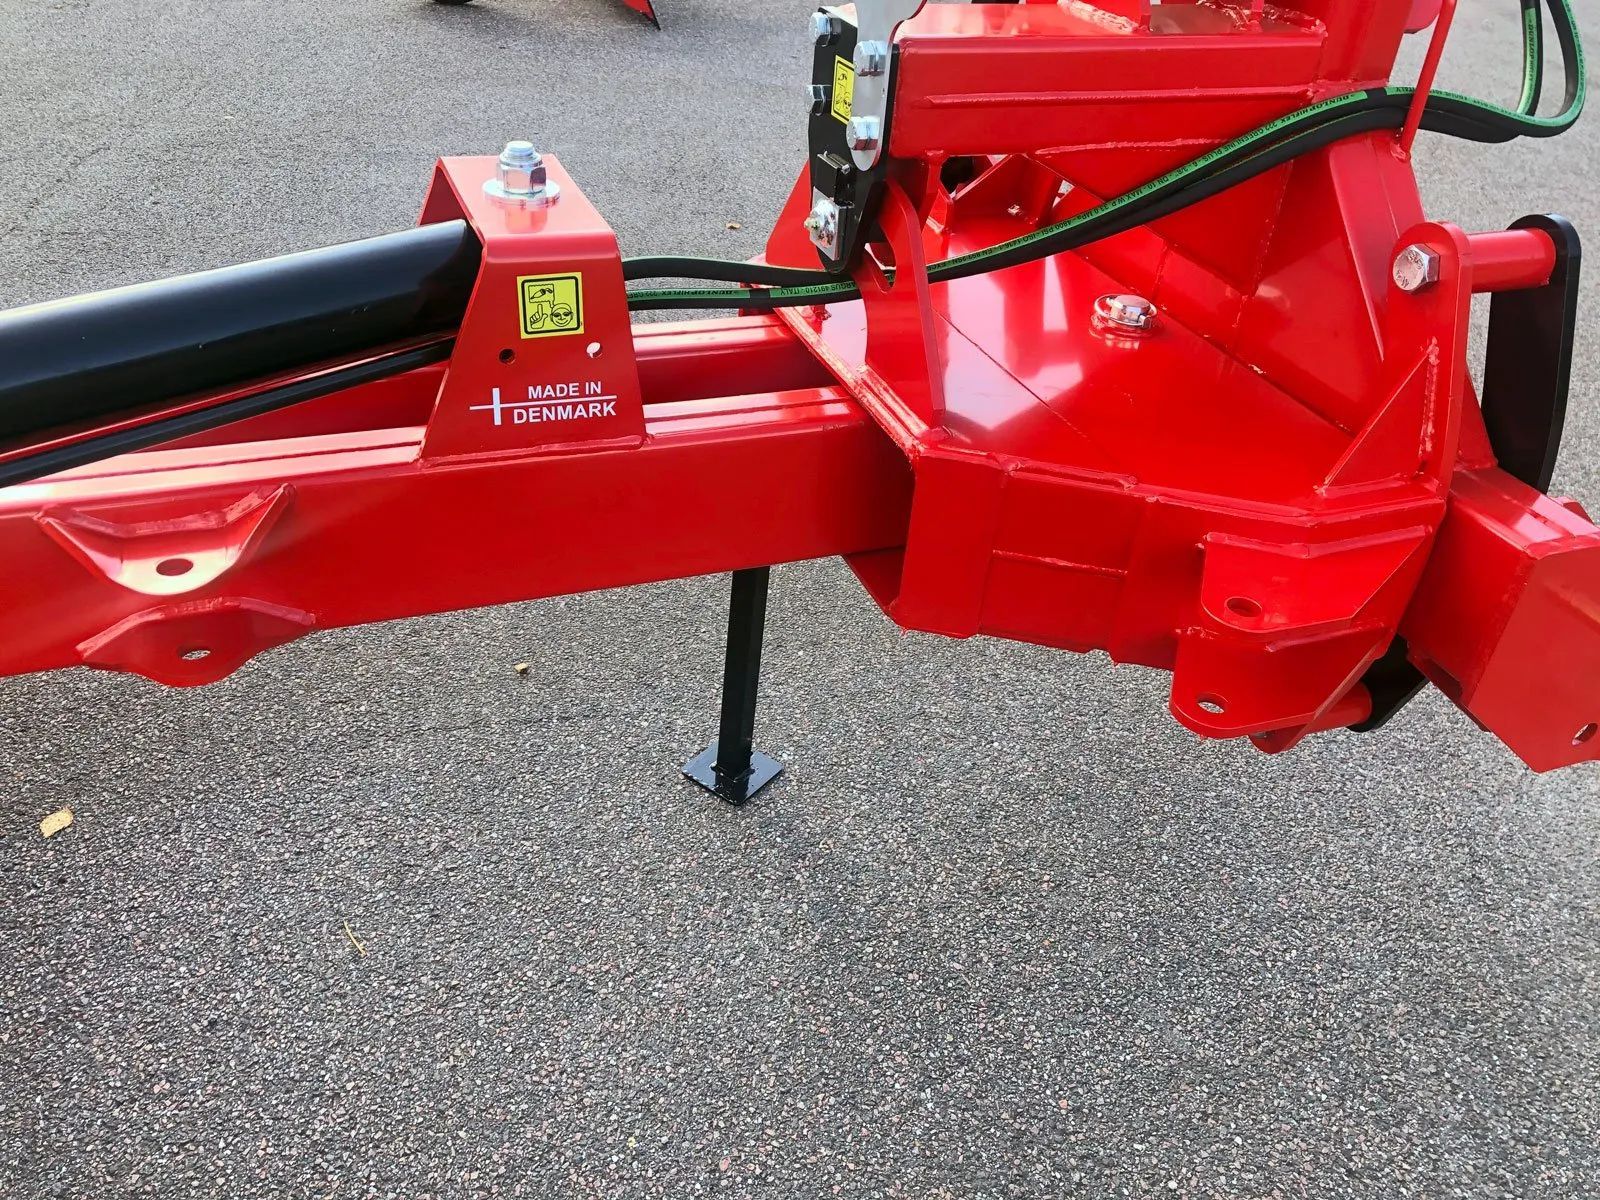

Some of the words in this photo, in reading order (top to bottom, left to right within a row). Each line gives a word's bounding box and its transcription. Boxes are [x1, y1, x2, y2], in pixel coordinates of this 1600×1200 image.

[1309, 95, 1350, 111] DUNLOP
[1280, 107, 1309, 123] HIFLEX
[1223, 128, 1264, 152] GREENLINE
[1201, 148, 1222, 162] PLUS
[1146, 181, 1156, 190] 10
[1157, 175, 1169, 186] DN
[1124, 188, 1143, 200] MAX
[1041, 226, 1054, 236] PSI
[1021, 233, 1036, 243] ISO
[661, 289, 691, 297] HIFLEX
[779, 286, 800, 296] ITALY
[528, 382, 580, 400] MADE
[585, 380, 602, 395] IN
[513, 400, 617, 425] DENMARK
